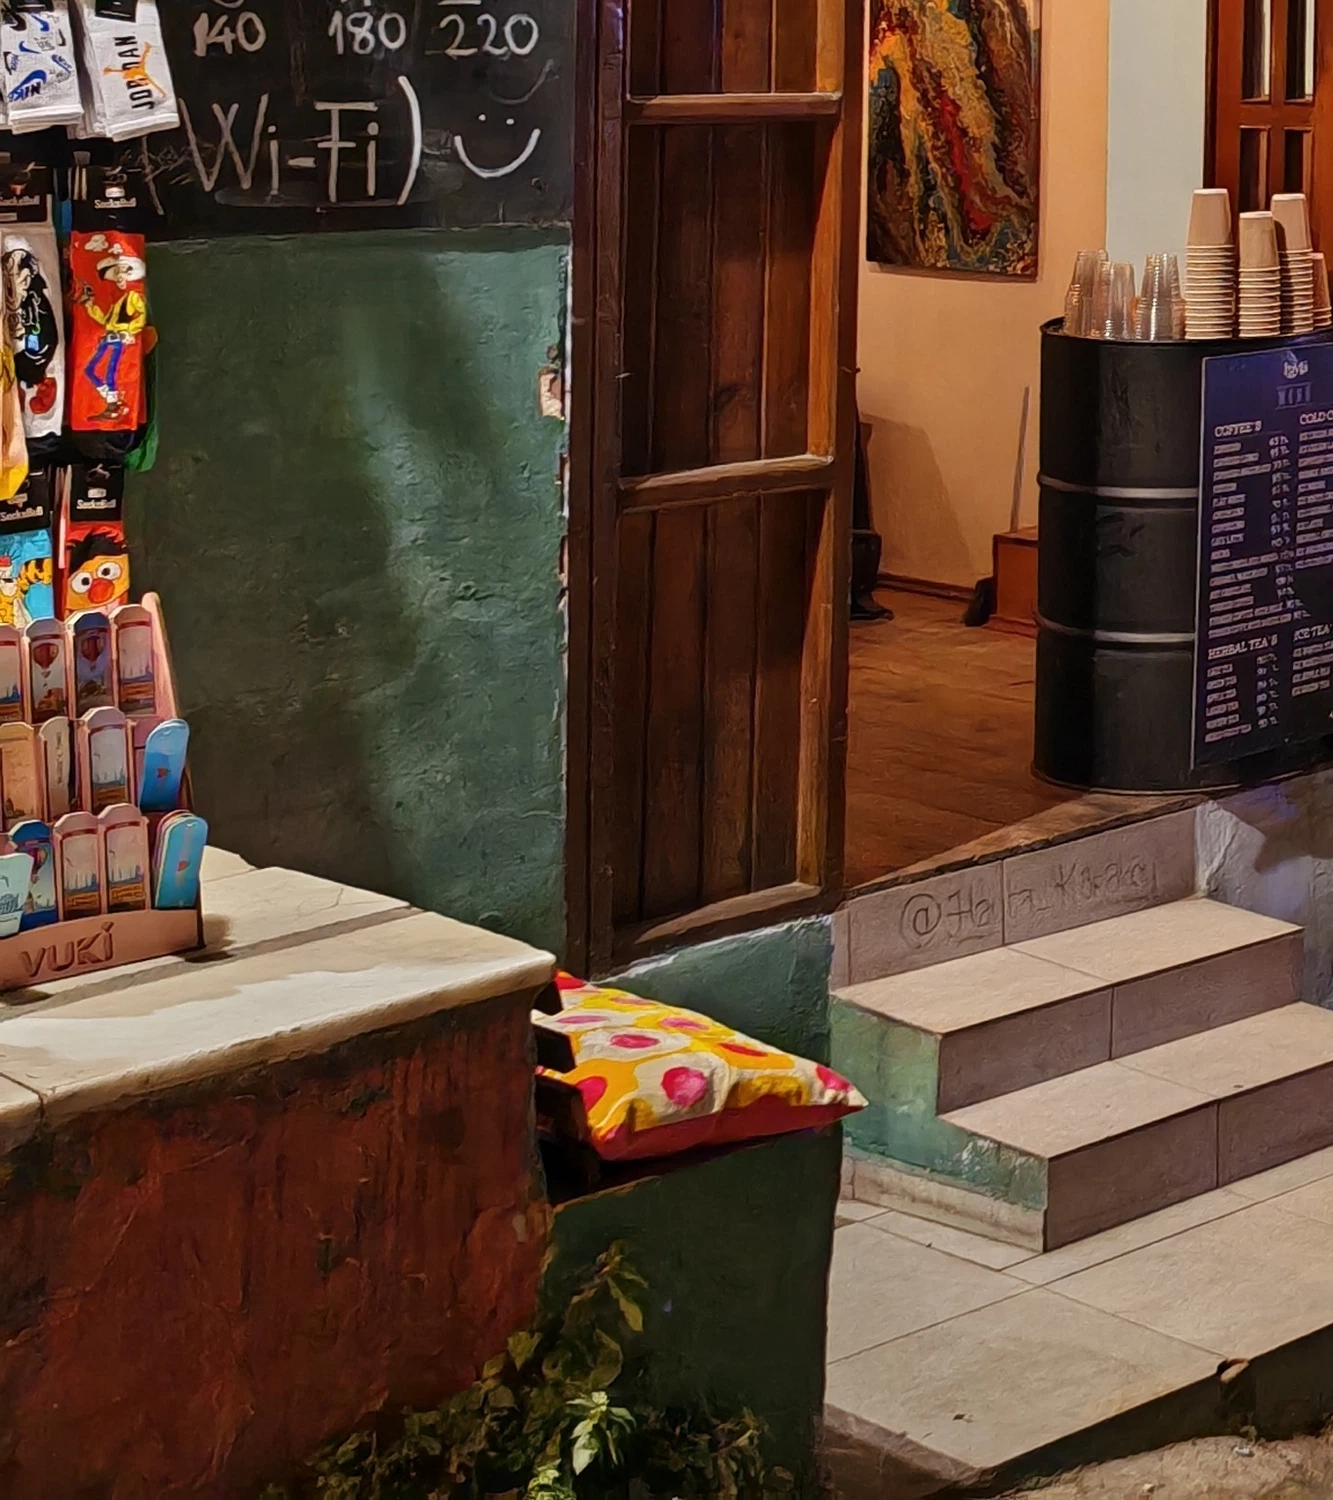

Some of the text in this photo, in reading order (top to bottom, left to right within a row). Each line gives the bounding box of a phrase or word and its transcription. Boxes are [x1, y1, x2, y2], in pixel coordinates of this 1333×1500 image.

[192, 9, 540, 62] 140 180 220
